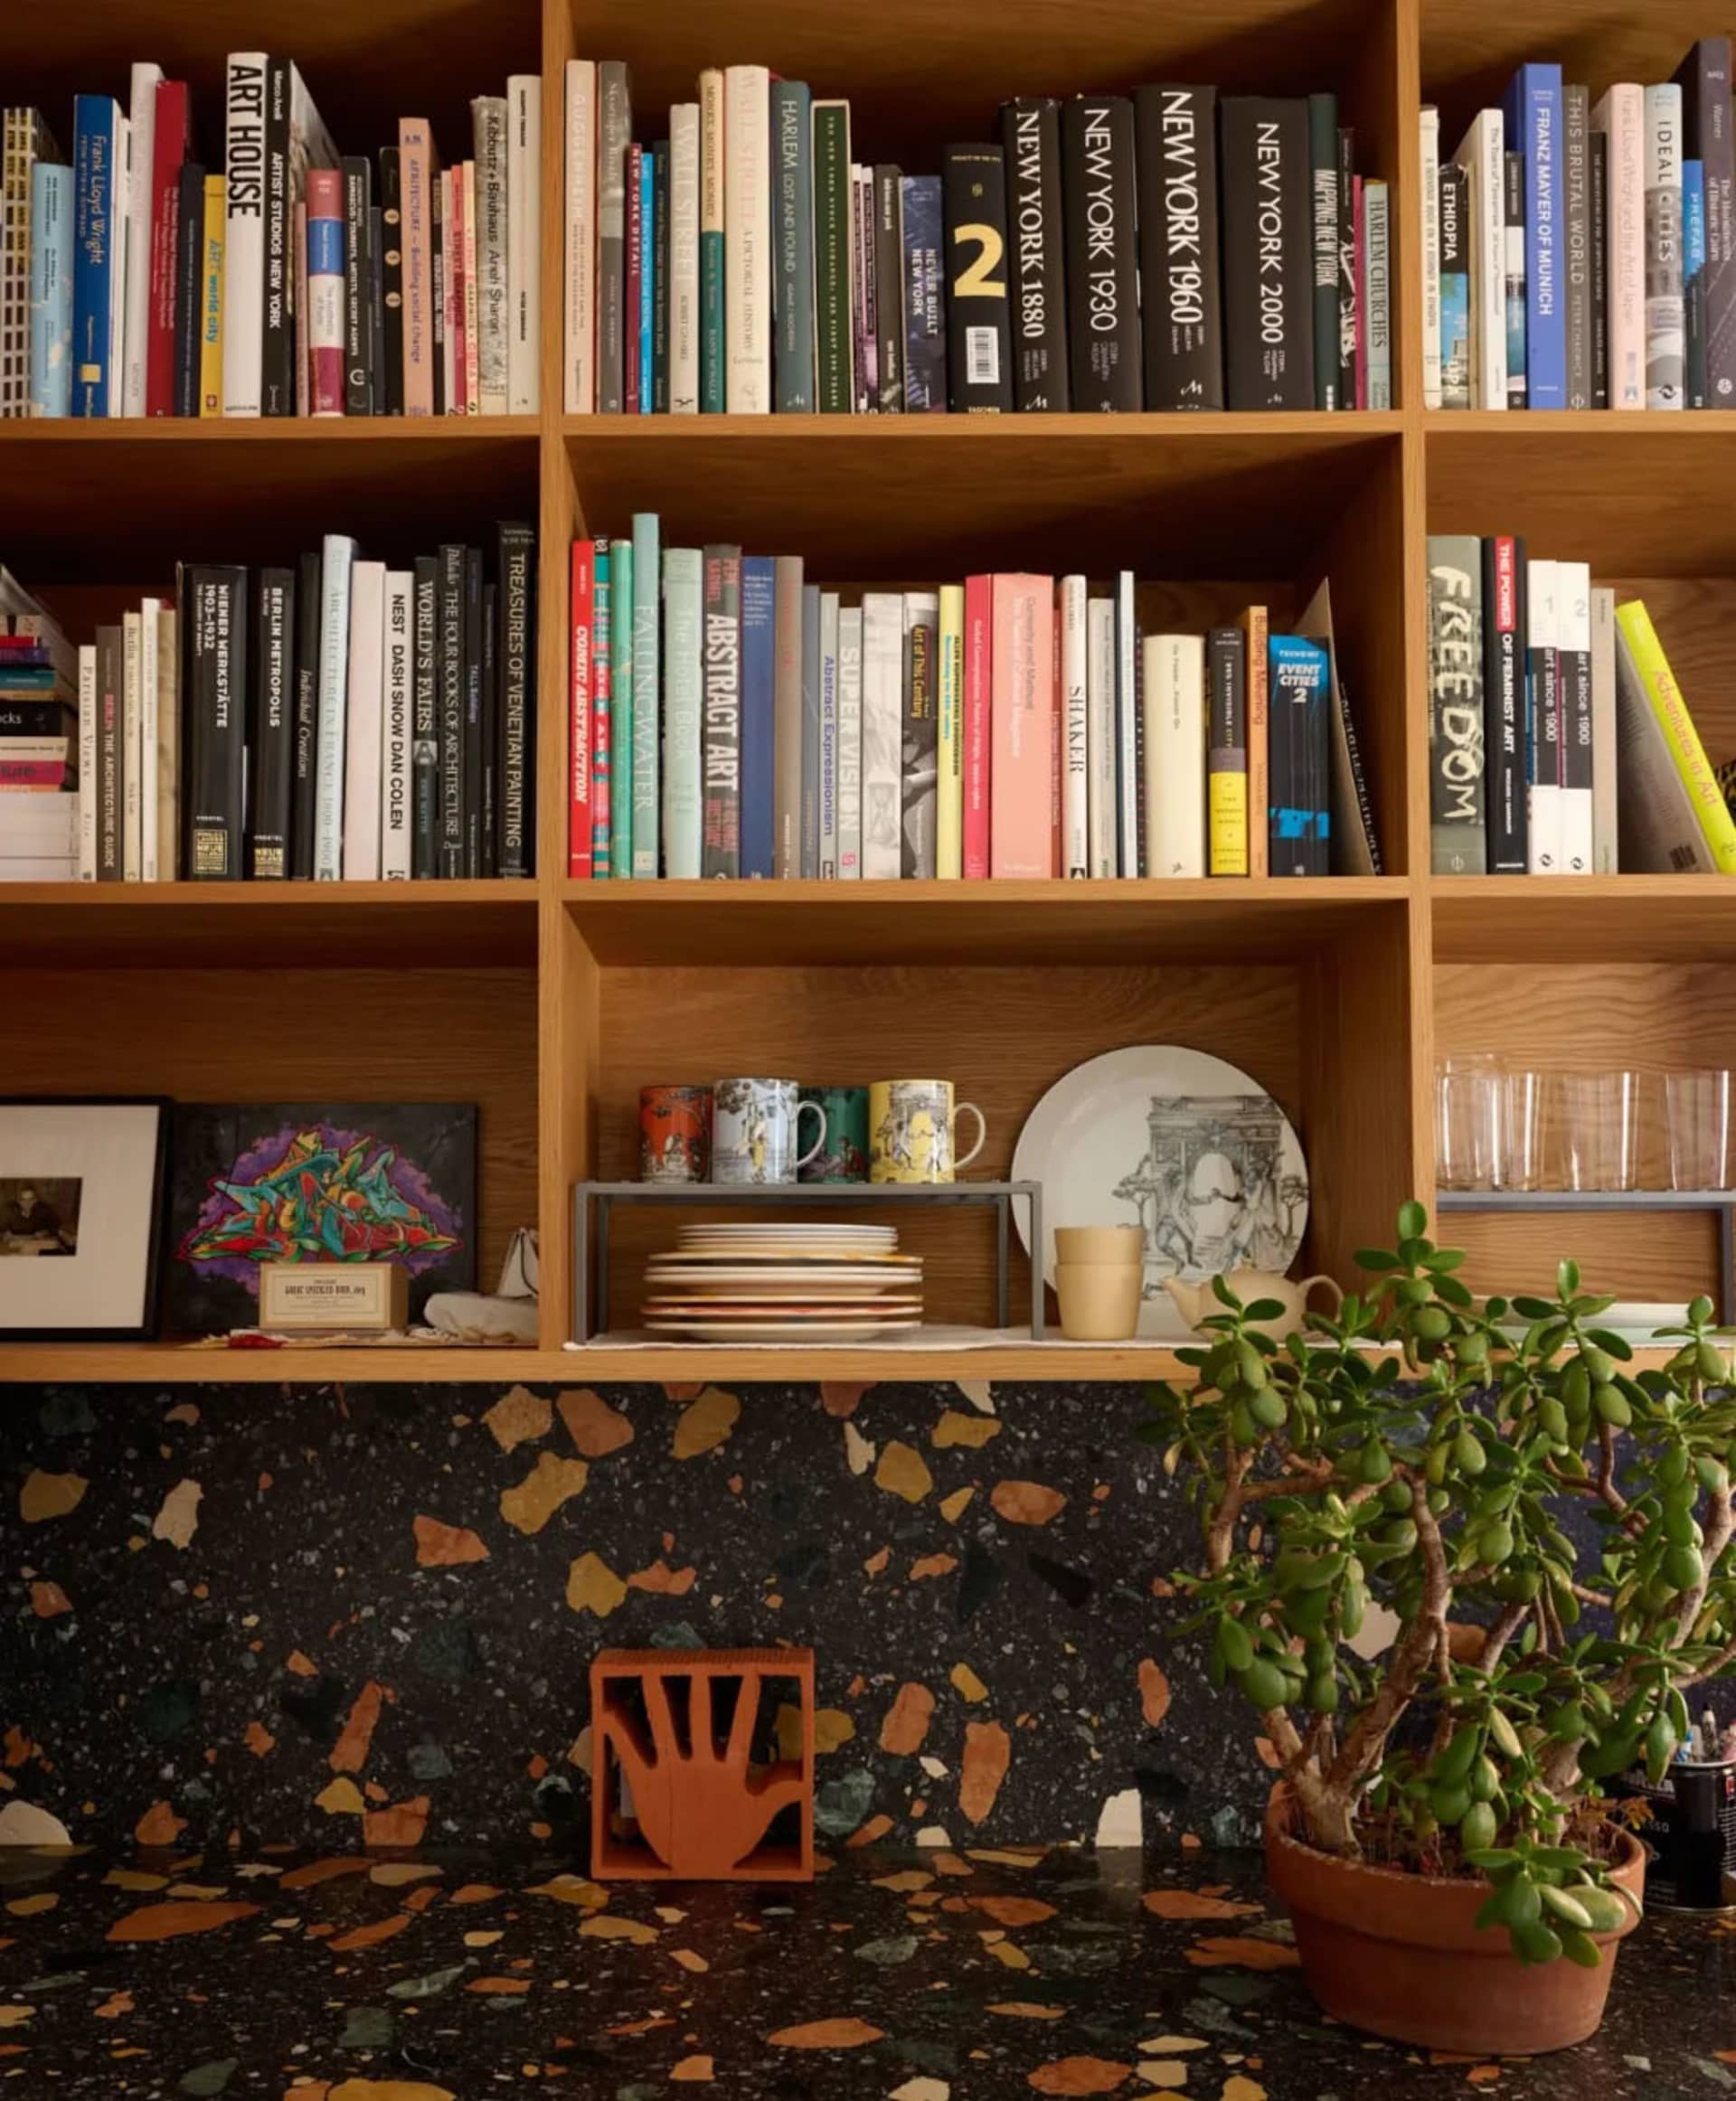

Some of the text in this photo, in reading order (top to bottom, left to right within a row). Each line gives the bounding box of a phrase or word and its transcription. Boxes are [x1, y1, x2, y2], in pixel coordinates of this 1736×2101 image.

[228, 64, 262, 219] ART HOUSE
[486, 115, 502, 170] Kibbutz
[781, 99, 797, 169] HARLEM
[1712, 104, 1723, 139] Warner
[85, 135, 107, 265] Frank Lloyd Wright
[269, 152, 283, 329] ARTIST STUDIOS NEW YORK
[487, 181, 503, 242] Bauhaus
[631, 147, 640, 277] NEW YORK DETAIL
[783, 172, 795, 199] LOST
[784, 203, 795, 228] AND
[1016, 109, 1046, 339] NEW YORK 1880
[1084, 108, 1118, 332] NEW YORK 1930
[1161, 90, 1204, 325] NEW YORK 1960
[1256, 122, 1285, 344] NEW YORK 2000
[1314, 168, 1338, 287] MAPPING NEW YORK
[1442, 183, 1458, 261] ETHIOPIA
[1537, 107, 1553, 316] FRANZ MAYER OF MUNICH
[1568, 96, 1584, 285] THIS BRUTAL WORLD
[1658, 120, 1675, 262] IDEAL CITIES
[205, 240, 221, 344] ART world city
[784, 231, 797, 273] FOUND
[912, 249, 924, 316] NEW YORK
[925, 249, 939, 335] NEVER BUILT
[954, 223, 1006, 298] 2
[1368, 200, 1388, 349] HARLEM CHURCHES
[489, 289, 502, 335] Sharon
[214, 584, 231, 728] WIENER WERKSTÄTTE
[269, 587, 284, 728] BERLIN METROPOLIS
[416, 579, 435, 731] WORLD'S FAIRS
[1499, 544, 1515, 753] THE POWER OF FEMINIST ART
[1574, 598, 1587, 617] 2
[82, 665, 93, 779] Parisian Views
[297, 668, 313, 779] Individual Creations
[390, 593, 405, 831] NEST DASH SNOW DAN COLEN
[445, 591, 460, 836] THE FOUR BOOKS OF ARCHITECTURE
[505, 553, 526, 848] TREASURES OF VENETIAN PAINTING
[574, 625, 589, 804] COMIC ABSTRACTION
[633, 604, 656, 812] FALLINGWATER
[706, 613, 739, 792] ABSTRACT ART
[910, 627, 926, 719] Art of This Century
[1250, 615, 1267, 725] Building Meaning
[1277, 663, 1322, 675] EVENT
[1278, 674, 1320, 688] CITIES
[1291, 687, 1308, 704] 2
[1430, 565, 1480, 819] FREEDOM
[1544, 648, 1558, 742] art since 1900
[1577, 651, 1590, 746] art since 1900
[104, 733, 114, 755] THE
[824, 655, 837, 836] Abstract Expressionism
[1068, 685, 1086, 774] SHAKER
[1654, 669, 1720, 807] Adventures in Art
[104, 756, 115, 833] ARCHITECTURE
[104, 835, 115, 868] GUIDE
